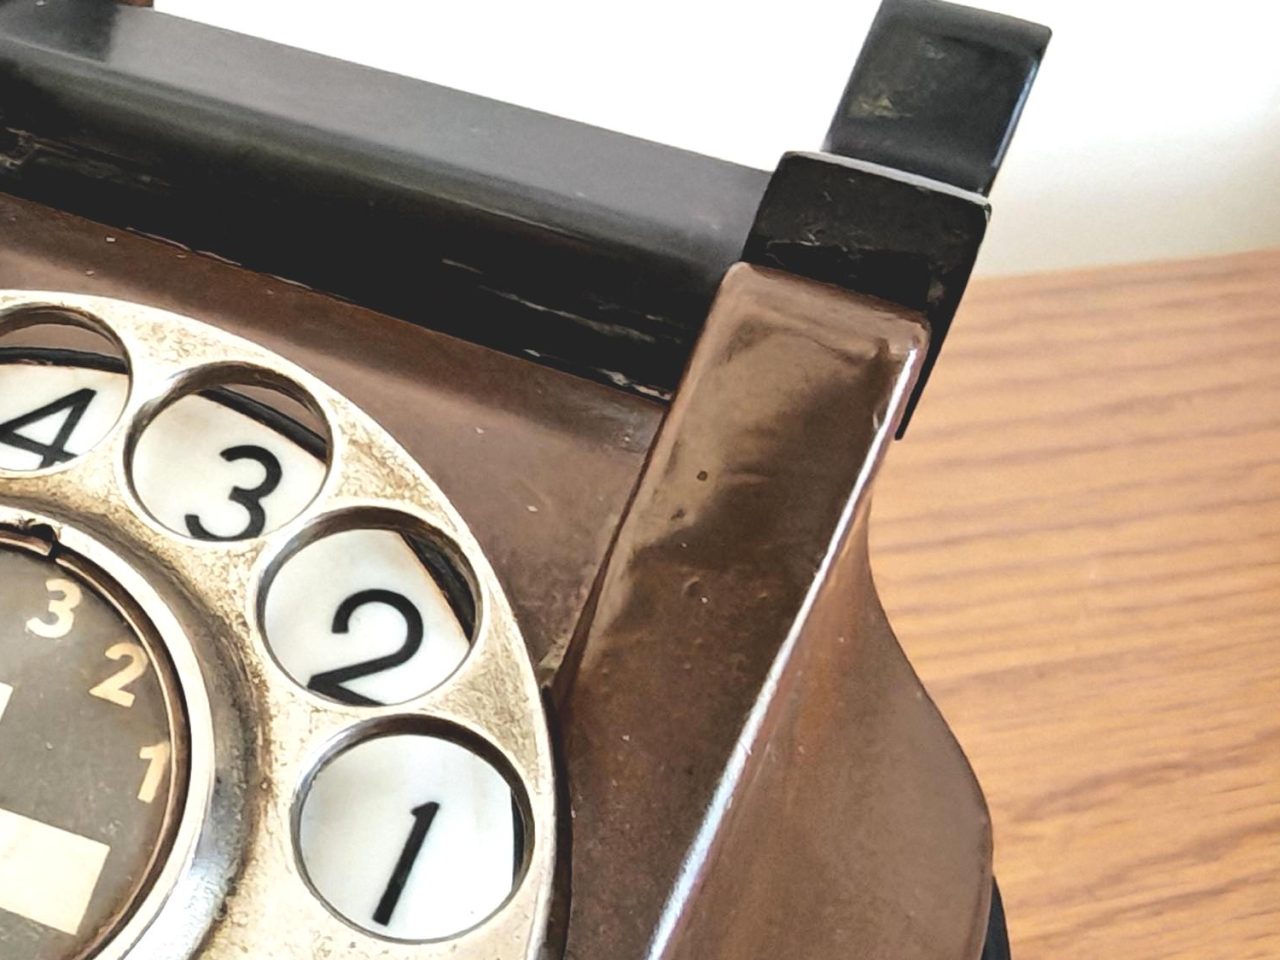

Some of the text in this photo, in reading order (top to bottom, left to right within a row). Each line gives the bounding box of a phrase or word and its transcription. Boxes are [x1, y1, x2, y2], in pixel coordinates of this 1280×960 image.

[185, 444, 283, 541] 3
[25, 578, 82, 639] 3
[308, 589, 424, 706] 2
[88, 643, 148, 708] 2
[137, 741, 170, 803] 1
[372, 800, 440, 927] 1
